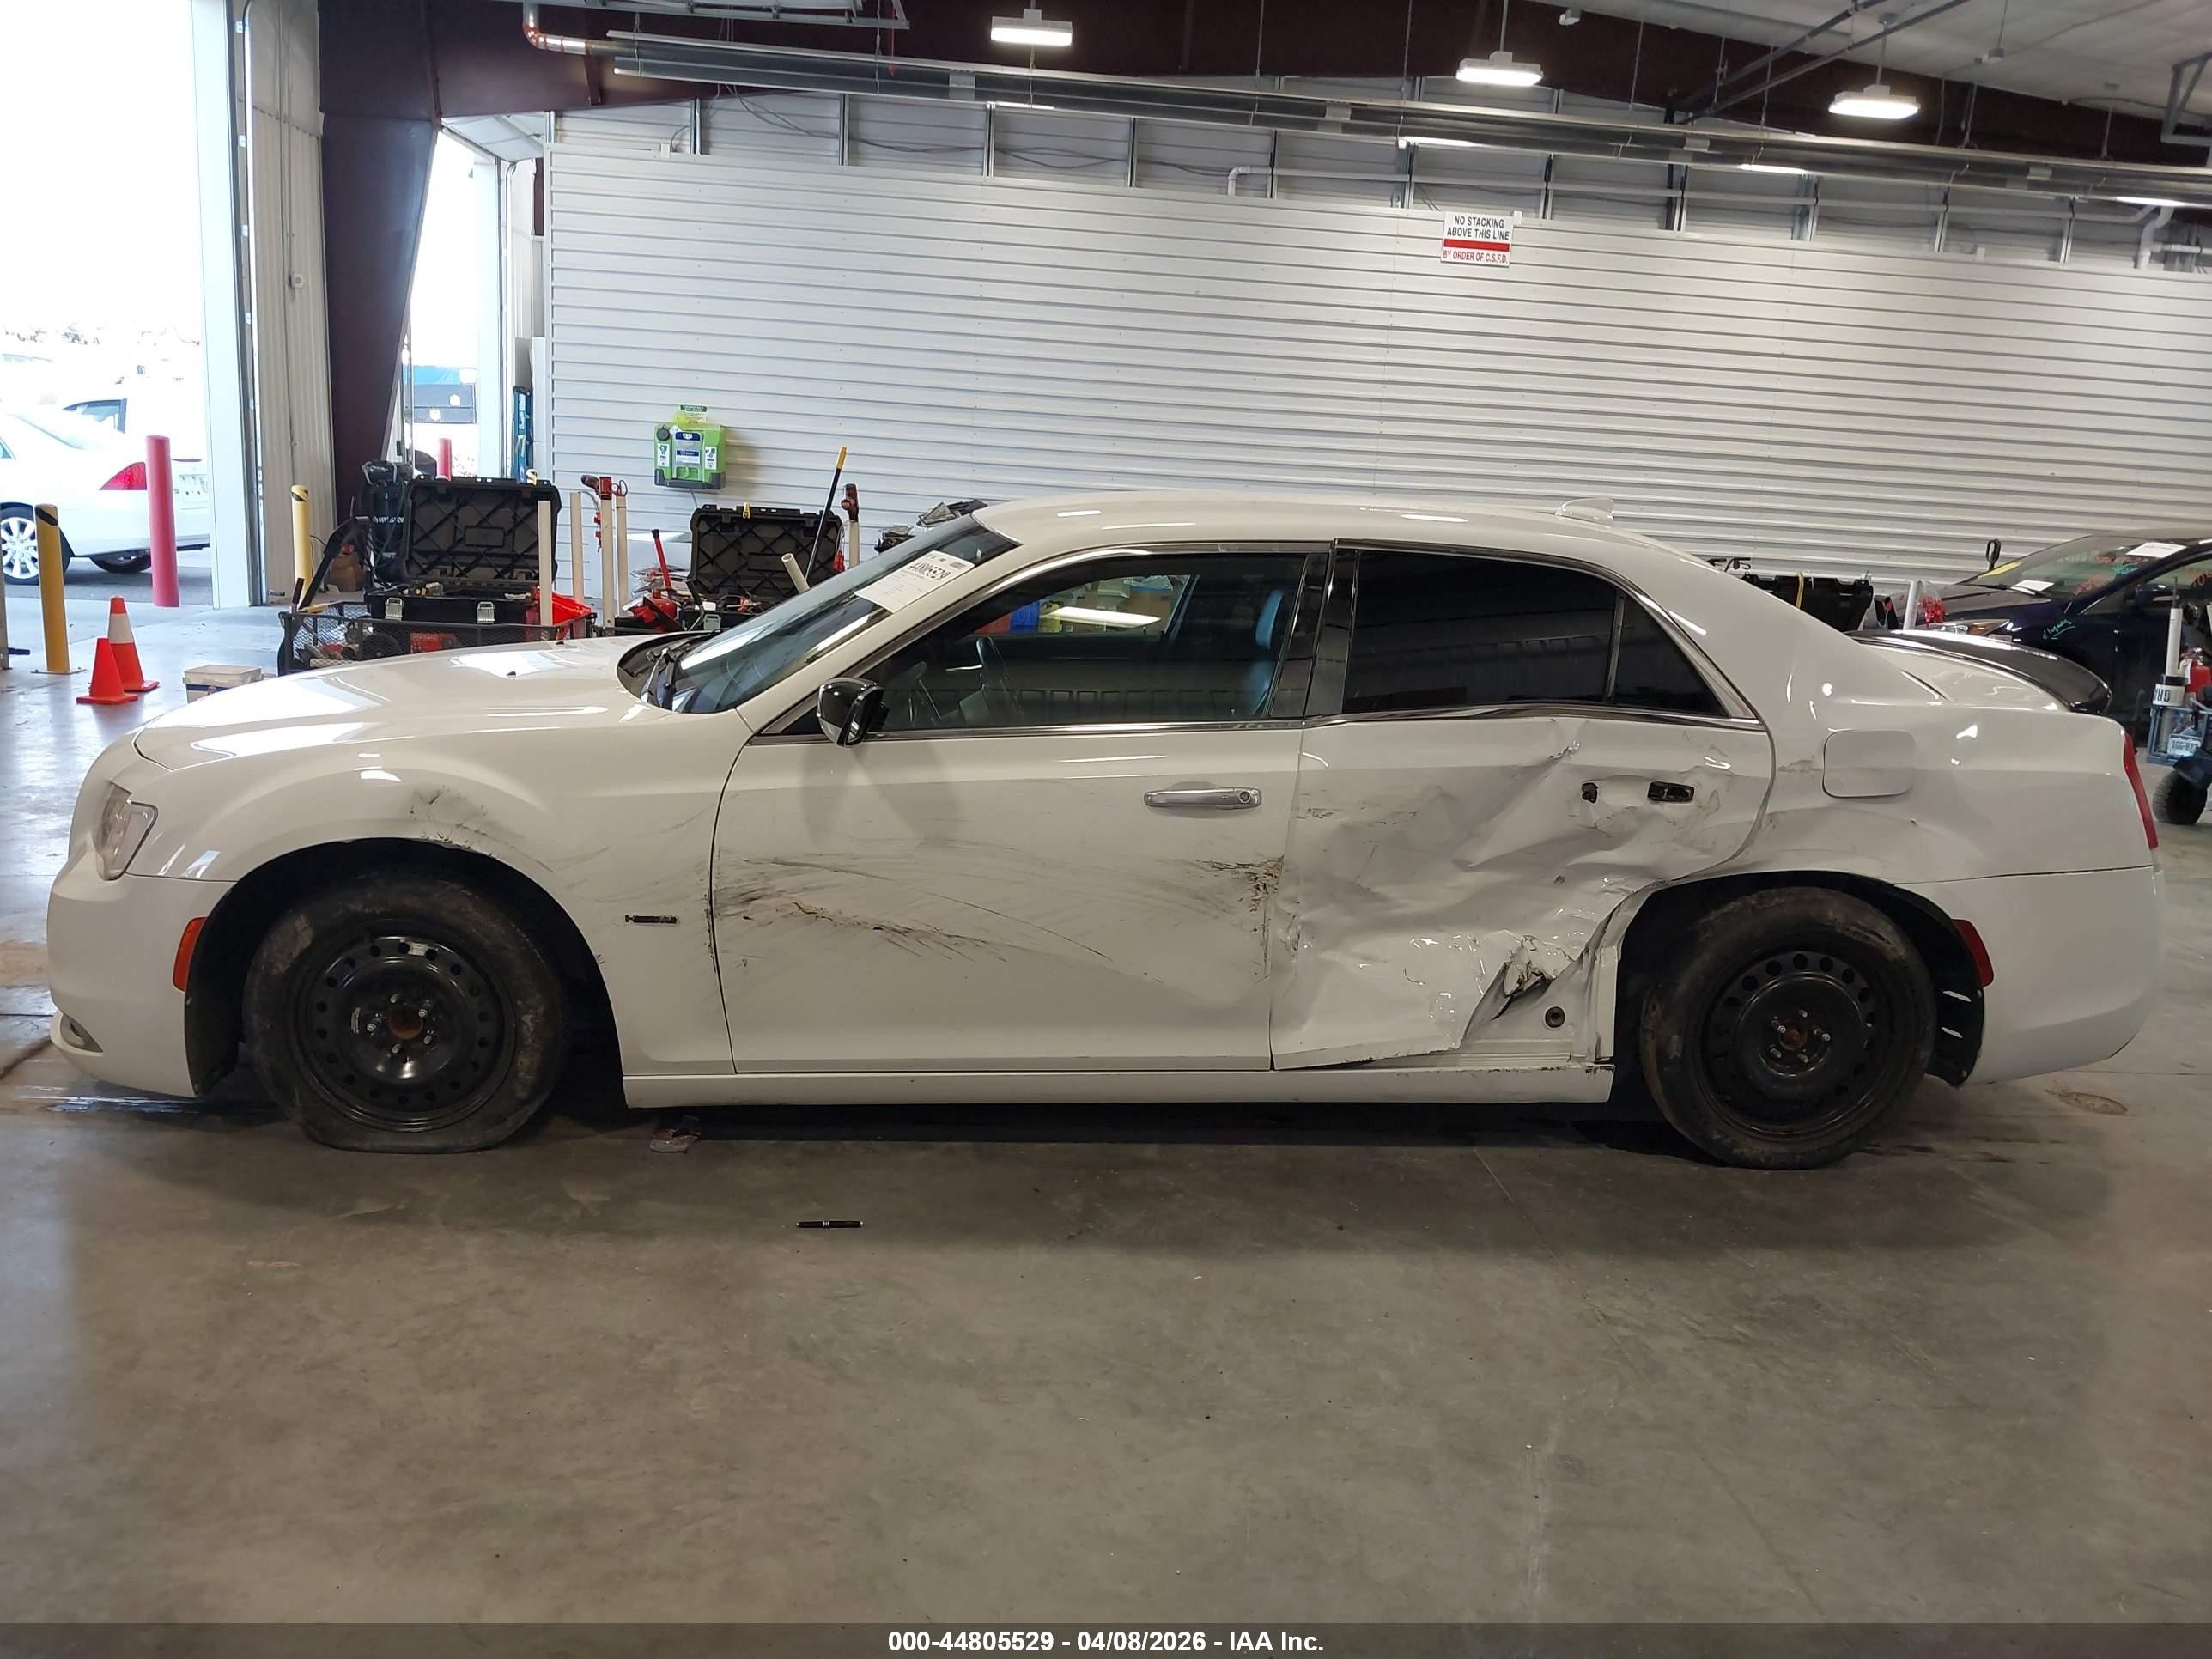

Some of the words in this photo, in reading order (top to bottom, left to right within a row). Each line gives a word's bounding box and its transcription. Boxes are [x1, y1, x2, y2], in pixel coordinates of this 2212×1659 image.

[1454, 216, 1465, 225] NO
[1468, 216, 1504, 228] STACKING
[1446, 227, 1472, 237] ABOVE
[1474, 228, 1491, 239] THIS
[1492, 230, 1510, 240] LINE
[1443, 250, 1452, 259] BY
[1453, 251, 1474, 261] ORDER
[1476, 252, 1484, 261] OF
